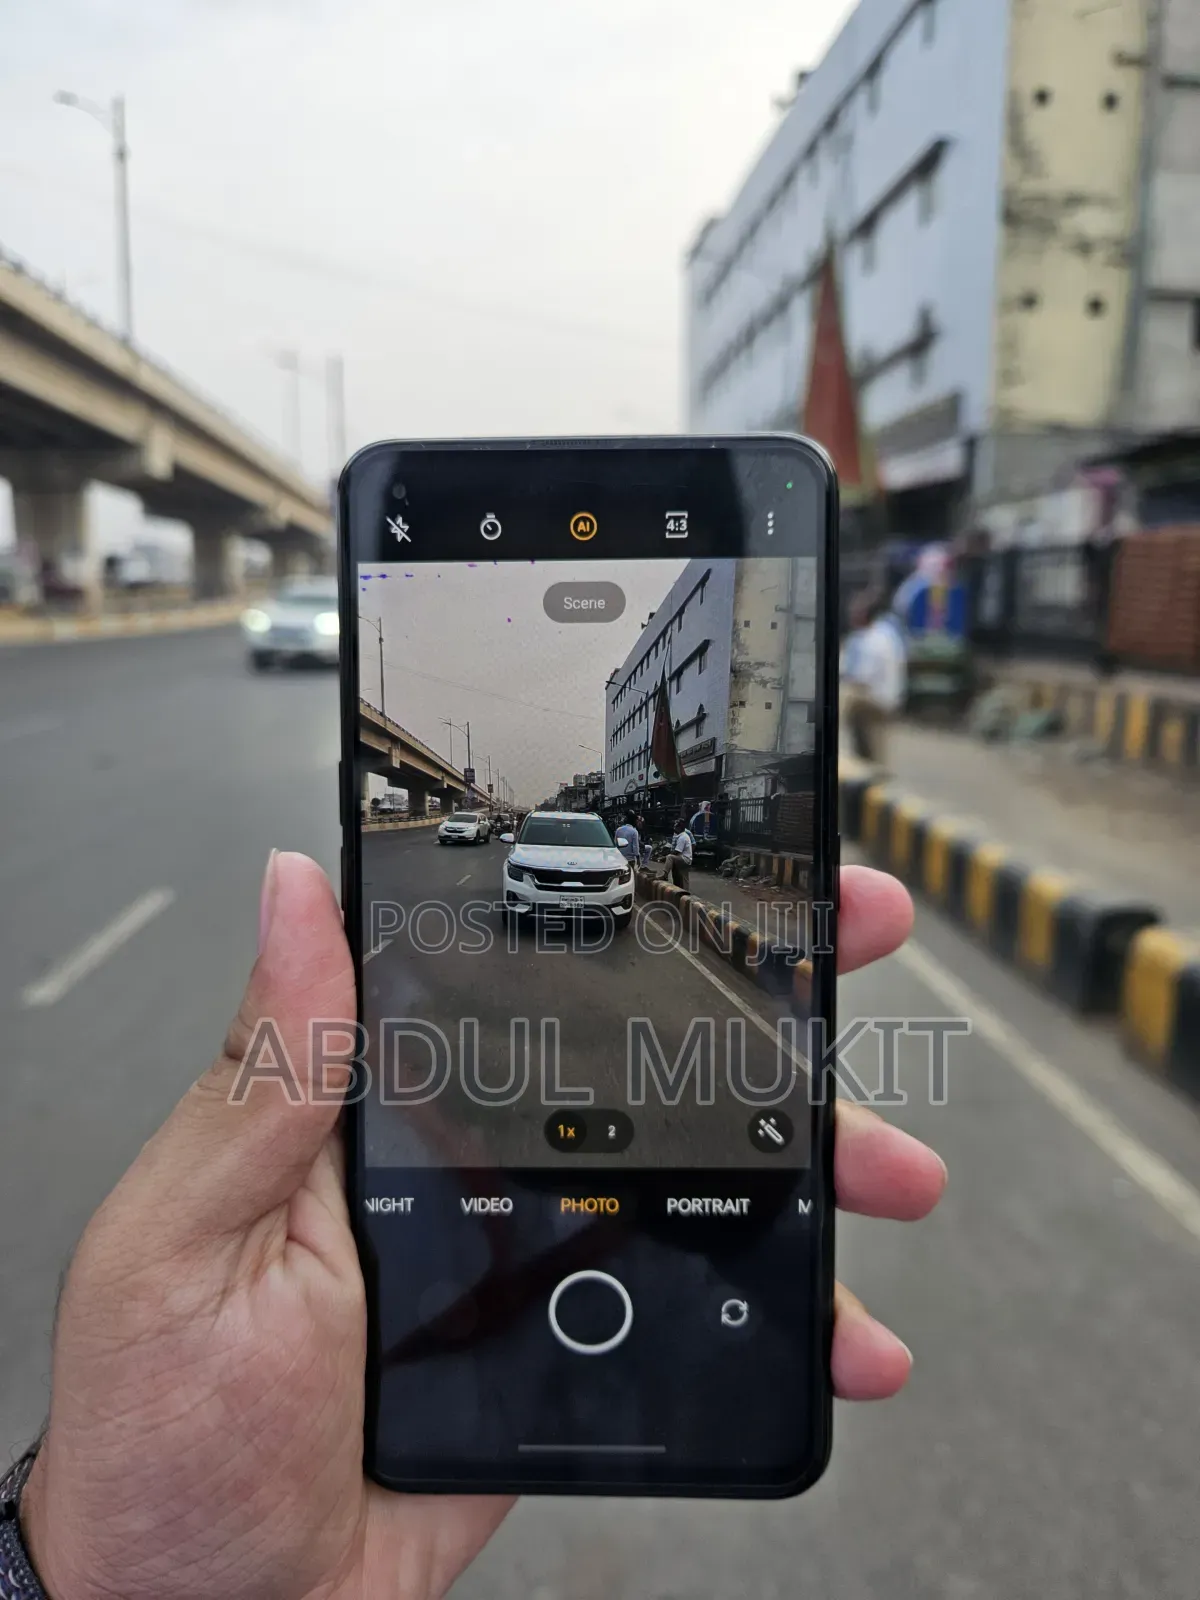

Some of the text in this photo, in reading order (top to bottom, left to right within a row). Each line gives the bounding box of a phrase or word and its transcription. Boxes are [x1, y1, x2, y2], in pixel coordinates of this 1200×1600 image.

[577, 521, 590, 533] AI
[666, 519, 687, 531] 4:3
[563, 596, 606, 610] Scene
[557, 1124, 576, 1138] 1x
[607, 1124, 617, 1138] 2
[460, 1197, 515, 1215] VIDEO
[559, 1197, 621, 1215] PHOTO
[666, 1197, 751, 1215] PORTRAIT
